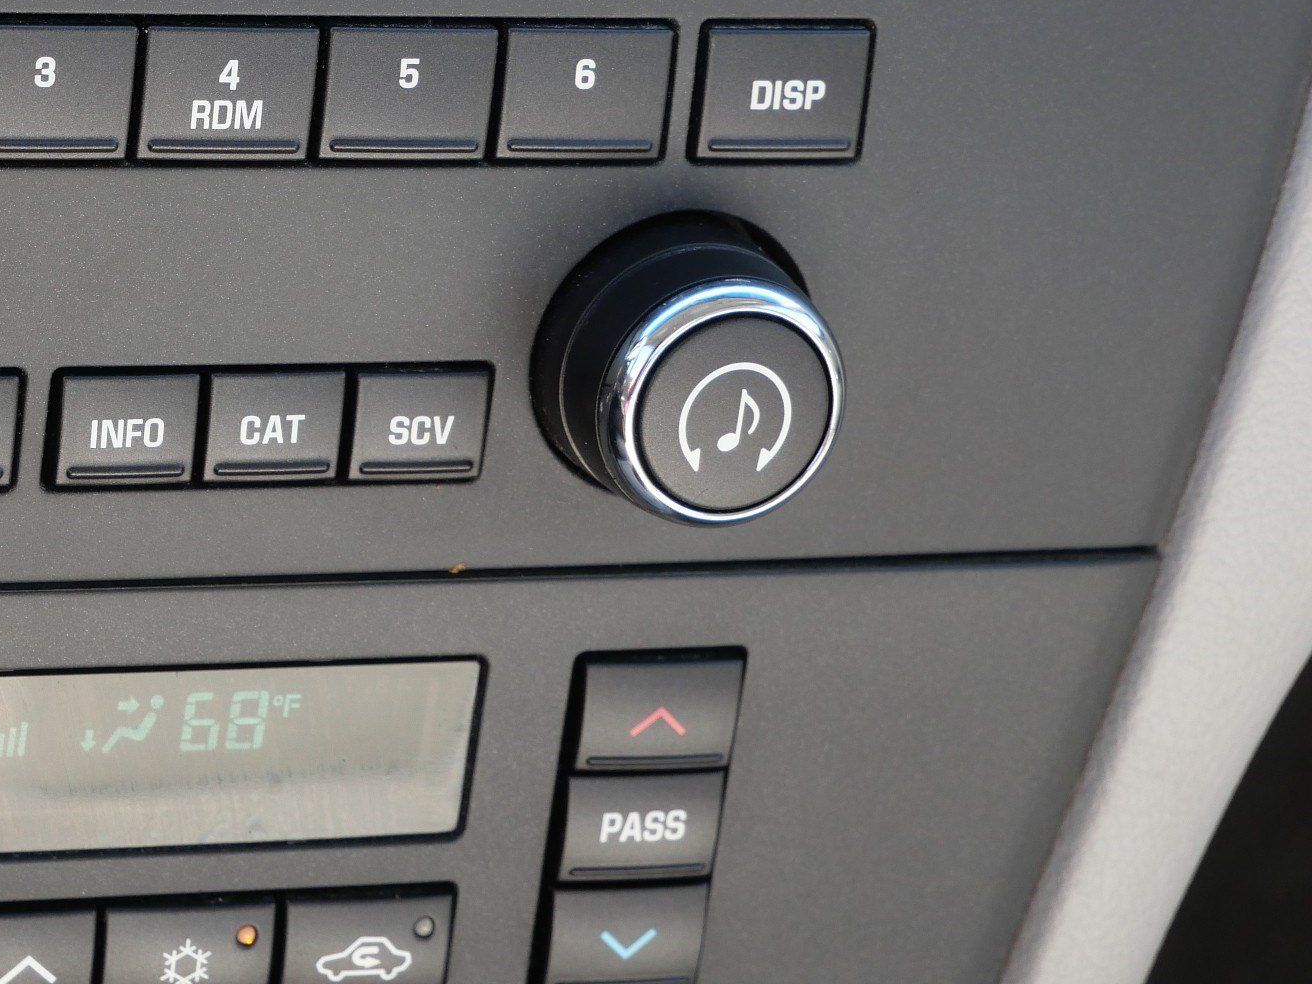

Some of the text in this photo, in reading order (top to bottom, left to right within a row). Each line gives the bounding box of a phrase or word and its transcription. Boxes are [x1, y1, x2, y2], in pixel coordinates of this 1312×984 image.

[34, 56, 56, 88] 3
[218, 59, 240, 91] 4
[398, 57, 421, 89] 5
[574, 58, 597, 90] 6
[749, 79, 826, 111] DISP
[190, 99, 264, 131] RDM
[89, 417, 165, 449] INFO
[239, 414, 306, 446] CAT
[387, 415, 455, 446] SCV
[599, 809, 687, 844] PASS
